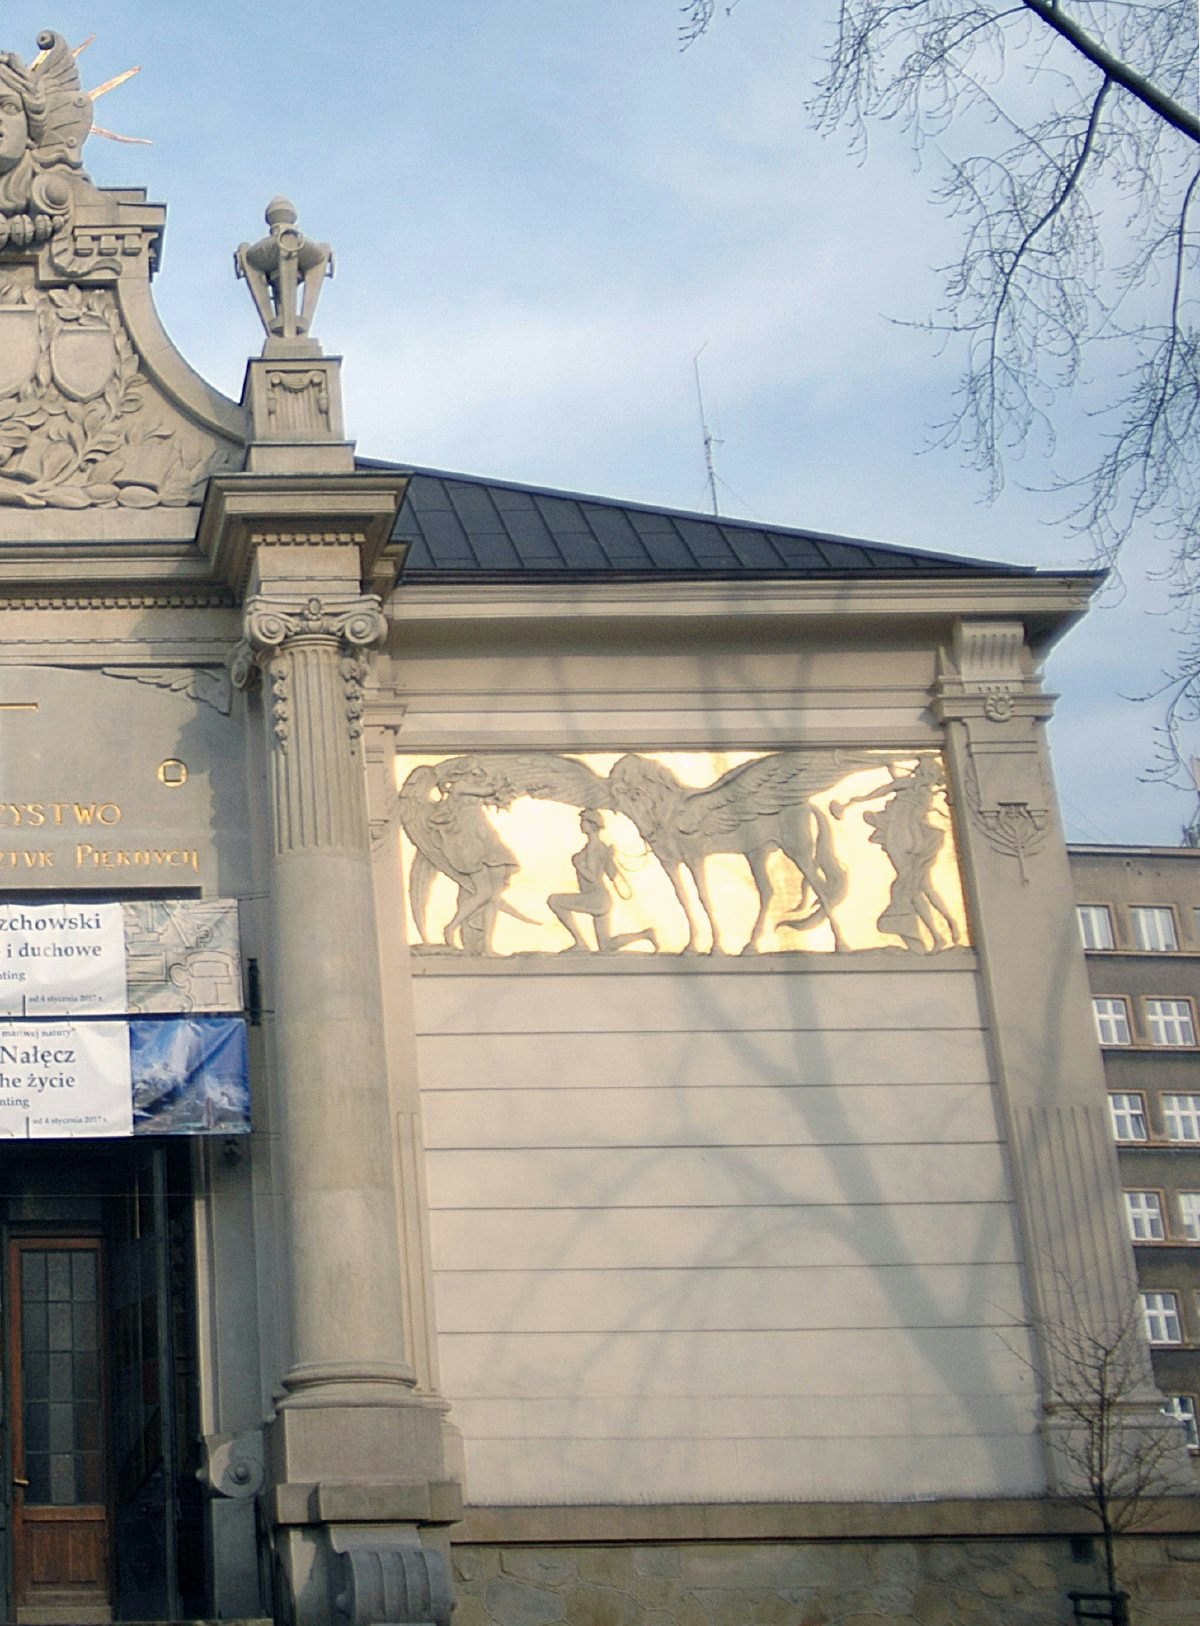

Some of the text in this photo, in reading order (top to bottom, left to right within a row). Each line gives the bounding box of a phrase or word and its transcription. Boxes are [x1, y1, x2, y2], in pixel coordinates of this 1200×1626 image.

[6, 943, 13, 958] i
[18, 942, 103, 958] duchowe
[0, 1045, 76, 1069] Nałęcz
[27, 1072, 76, 1093] życie
